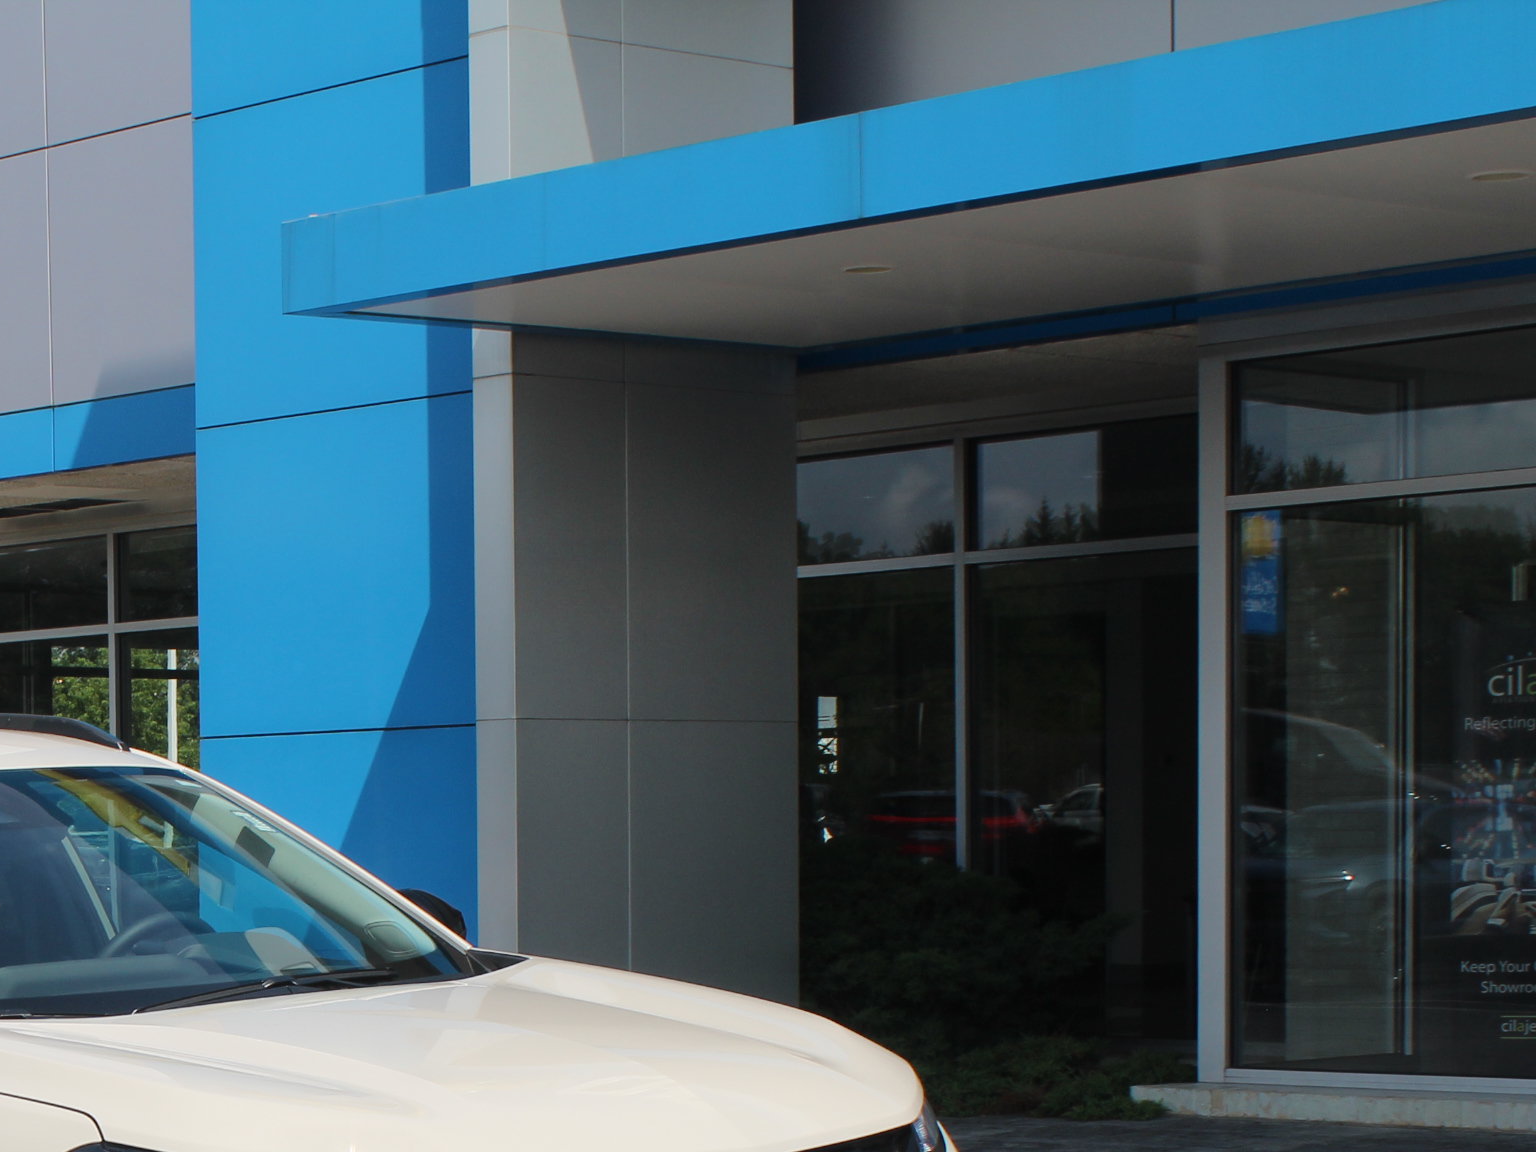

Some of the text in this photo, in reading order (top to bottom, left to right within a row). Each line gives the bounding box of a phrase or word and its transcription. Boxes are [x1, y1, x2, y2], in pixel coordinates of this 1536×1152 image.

[1464, 717, 1536, 731] Reflecting
[1461, 961, 1495, 975] Keep
[1499, 961, 1530, 973] Your
